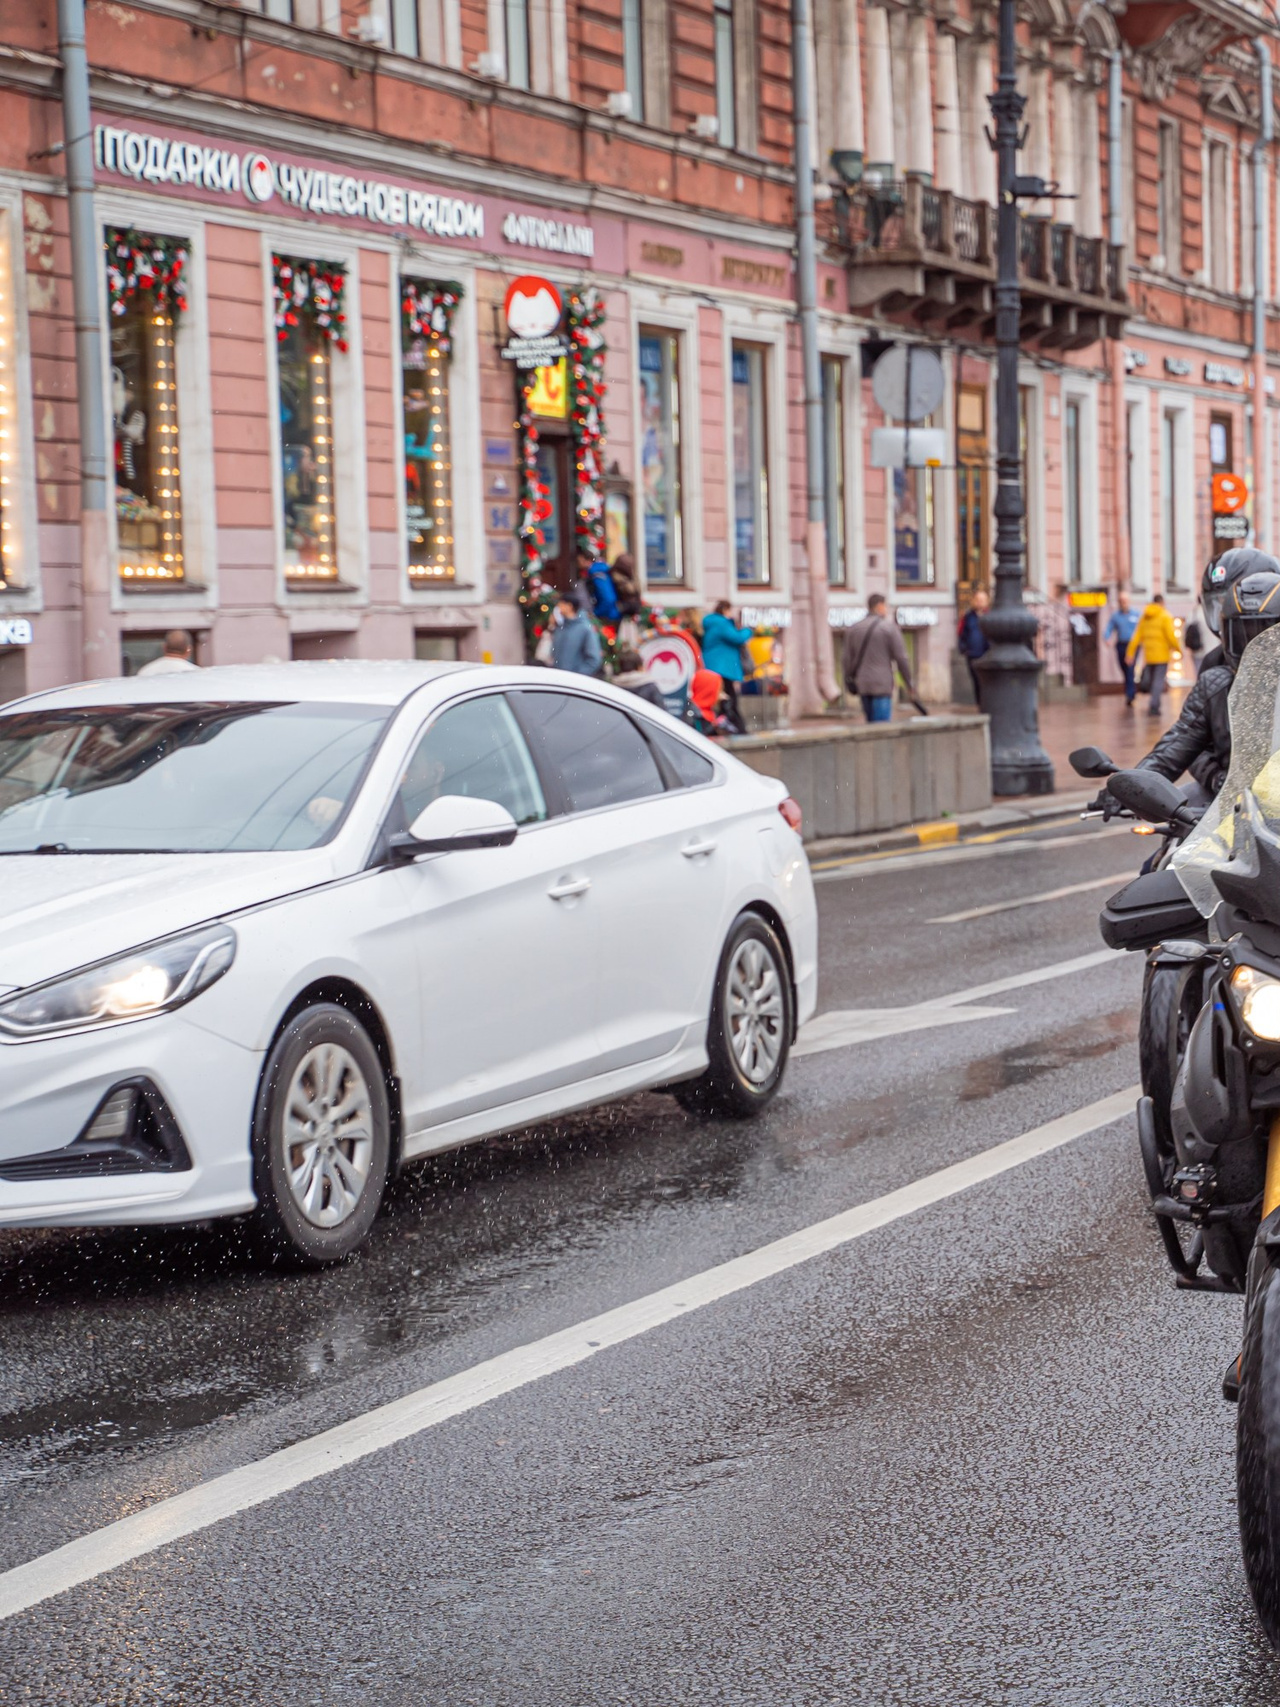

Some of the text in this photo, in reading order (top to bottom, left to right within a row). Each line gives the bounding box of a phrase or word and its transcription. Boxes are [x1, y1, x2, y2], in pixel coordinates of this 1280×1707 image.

[96, 125, 484, 239] ПОДАРКИ ЧУДЕСНОЕ РЯДОМ
